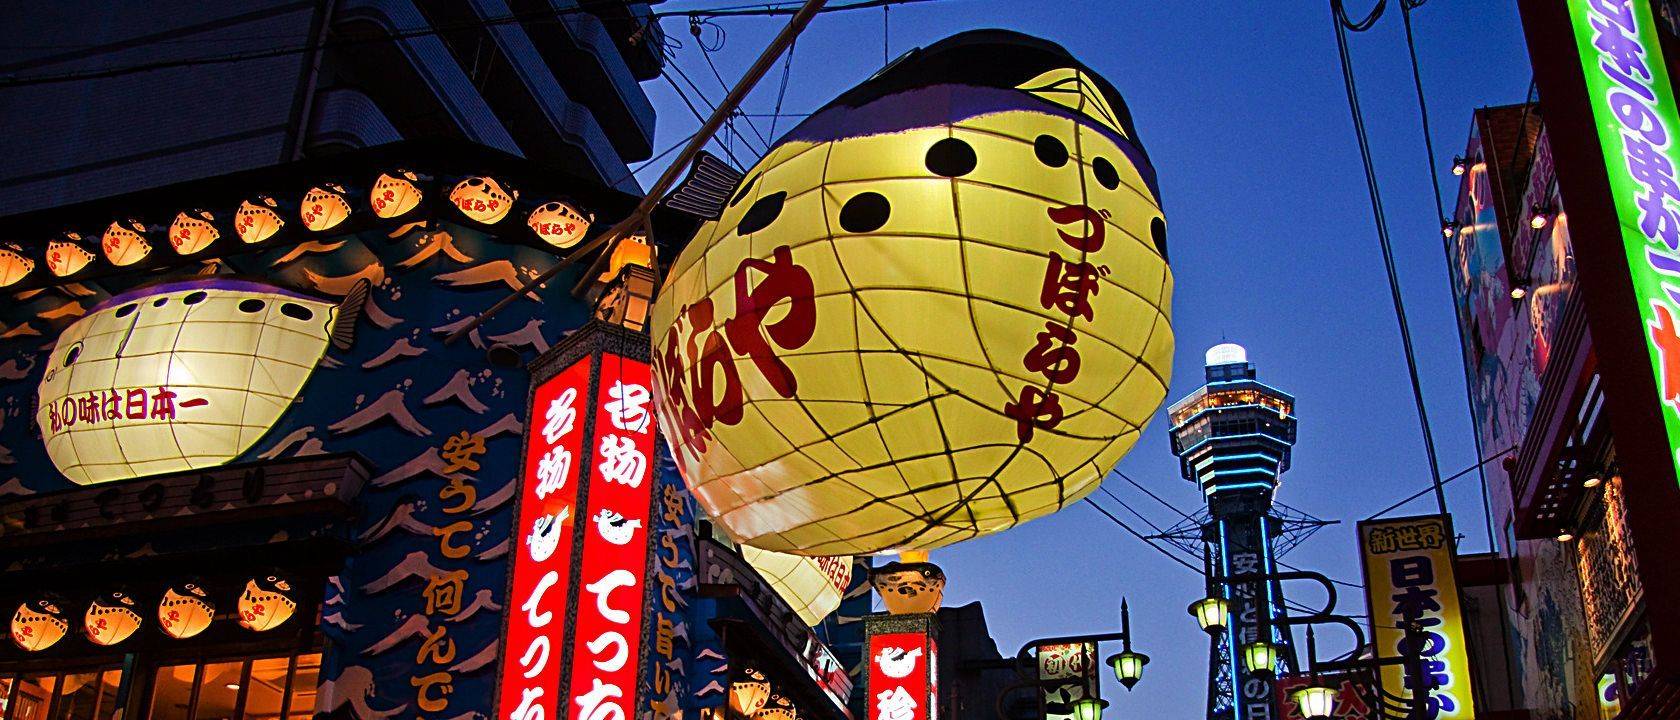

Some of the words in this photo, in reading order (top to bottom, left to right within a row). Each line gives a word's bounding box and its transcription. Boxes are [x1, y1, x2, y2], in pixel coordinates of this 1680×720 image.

[1004, 204, 1112, 443] づぼらや
[410, 431, 486, 720] 安うて何んで
[1369, 523, 1446, 554] 新世界
